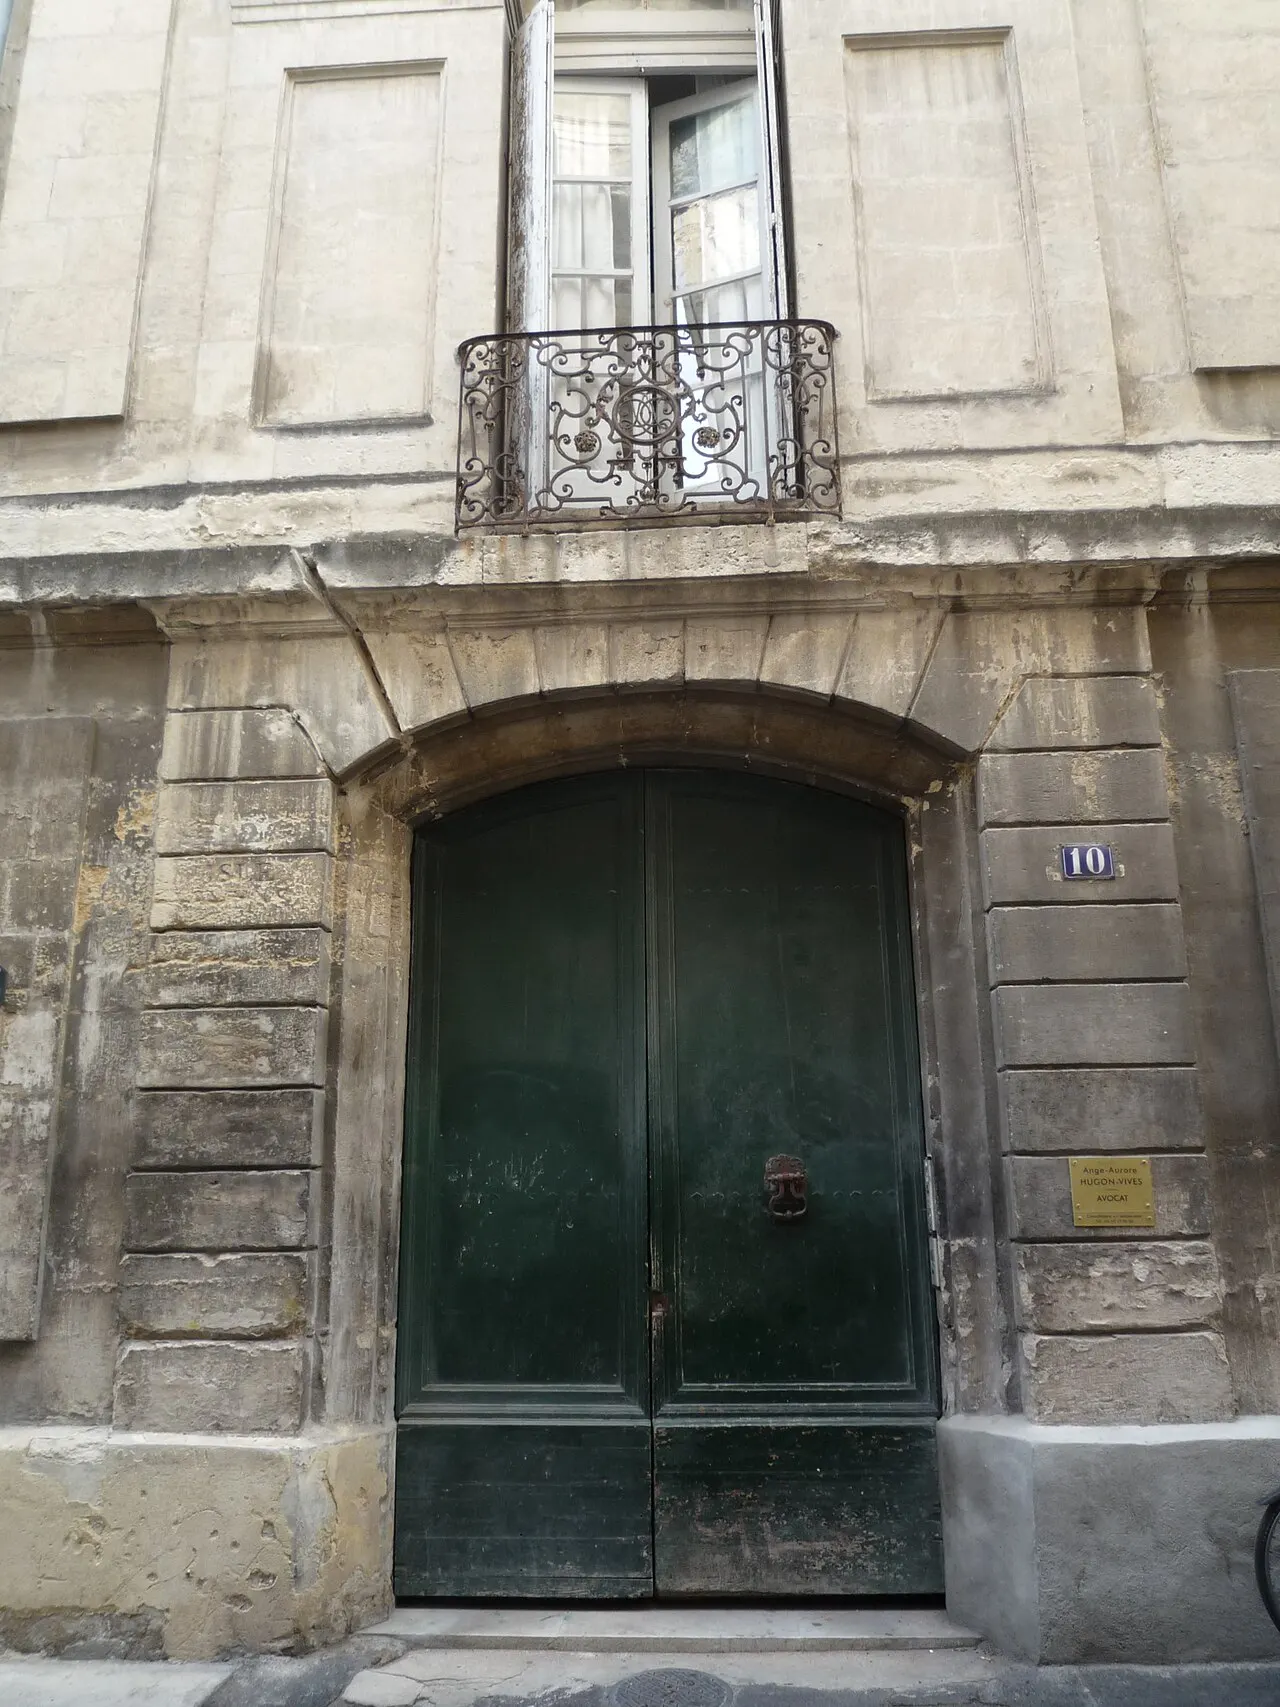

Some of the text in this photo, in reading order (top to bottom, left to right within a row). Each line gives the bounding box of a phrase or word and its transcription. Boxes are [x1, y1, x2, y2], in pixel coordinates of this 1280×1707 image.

[1070, 847, 1105, 874] 10
[1083, 1167, 1137, 1175] Ange-Aurore
[1080, 1178, 1143, 1186] HUGON-VIVES
[1097, 1194, 1128, 1202] AVOCAT
